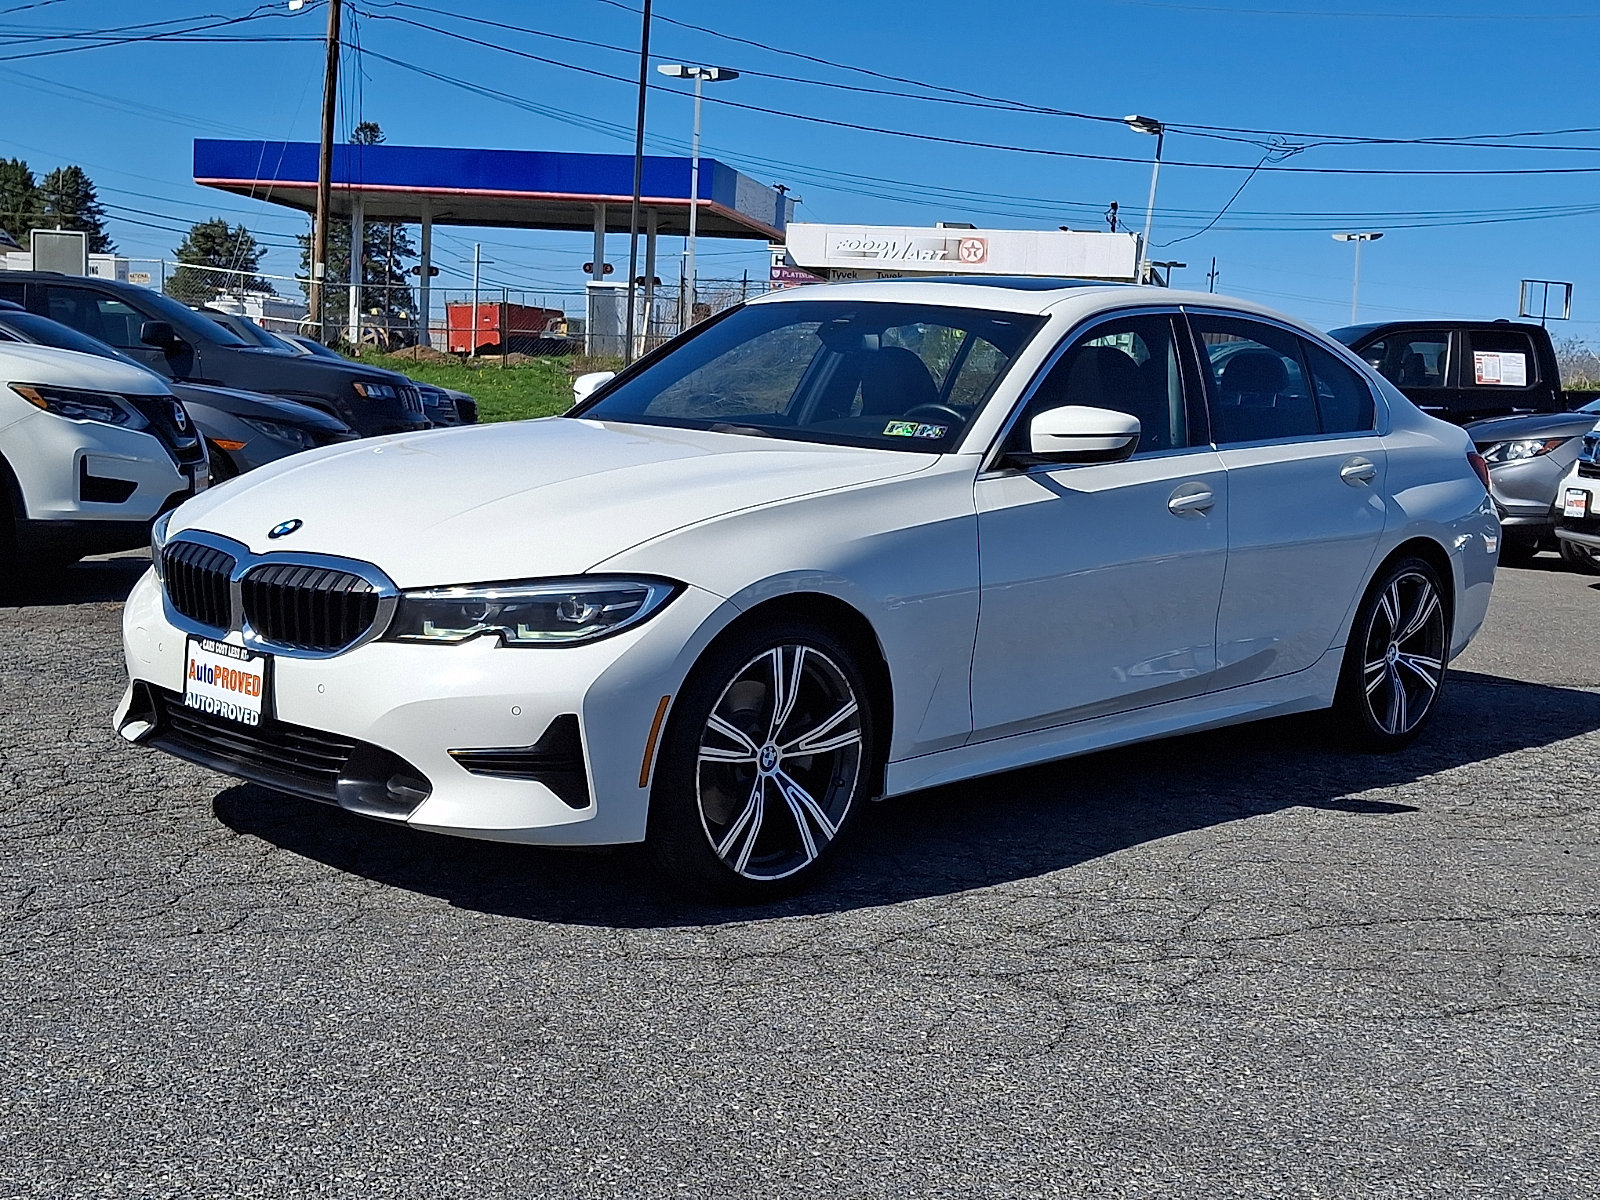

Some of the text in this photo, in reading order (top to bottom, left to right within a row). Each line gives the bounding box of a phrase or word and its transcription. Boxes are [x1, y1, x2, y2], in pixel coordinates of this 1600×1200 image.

[831, 269, 858, 281] Tyvek
[188, 658, 261, 697] AutoPROVED
[184, 691, 259, 726] AUTOPROVED
